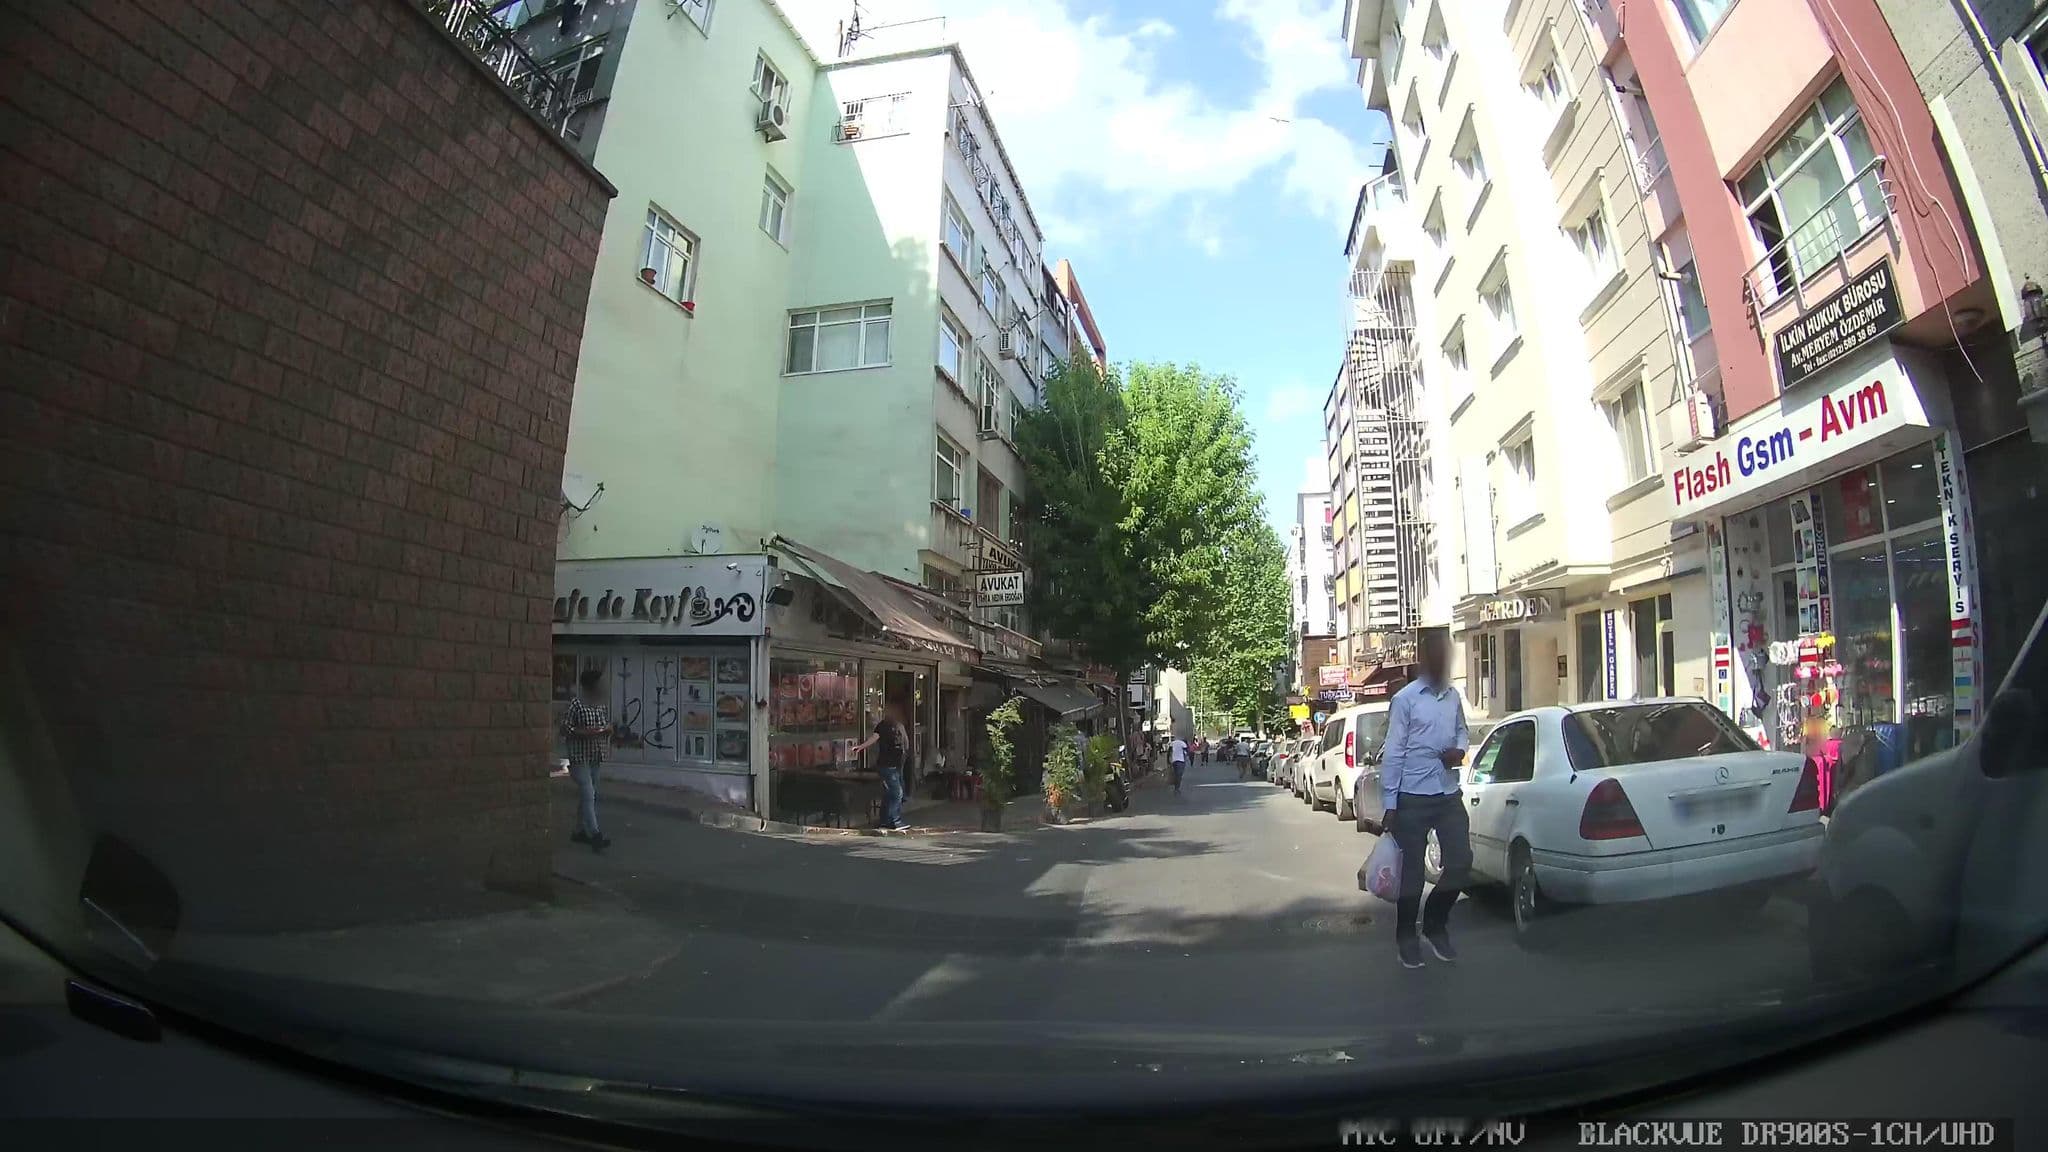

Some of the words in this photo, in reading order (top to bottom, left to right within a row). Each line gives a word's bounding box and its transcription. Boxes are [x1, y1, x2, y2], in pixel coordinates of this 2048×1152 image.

[1780, 323, 1806, 353] İLKİN
[1806, 299, 1843, 337] HUKUK
[1842, 269, 1886, 313] BÜROSU
[1839, 298, 1886, 337] ÖZDEMİR
[1674, 451, 1731, 505] Flash
[1737, 427, 1794, 477] Gsm
[1821, 380, 1888, 442] Avm
[980, 575, 1019, 591] AVUKAT
[553, 587, 590, 624] afe
[1484, 597, 1552, 621] GARDEN
